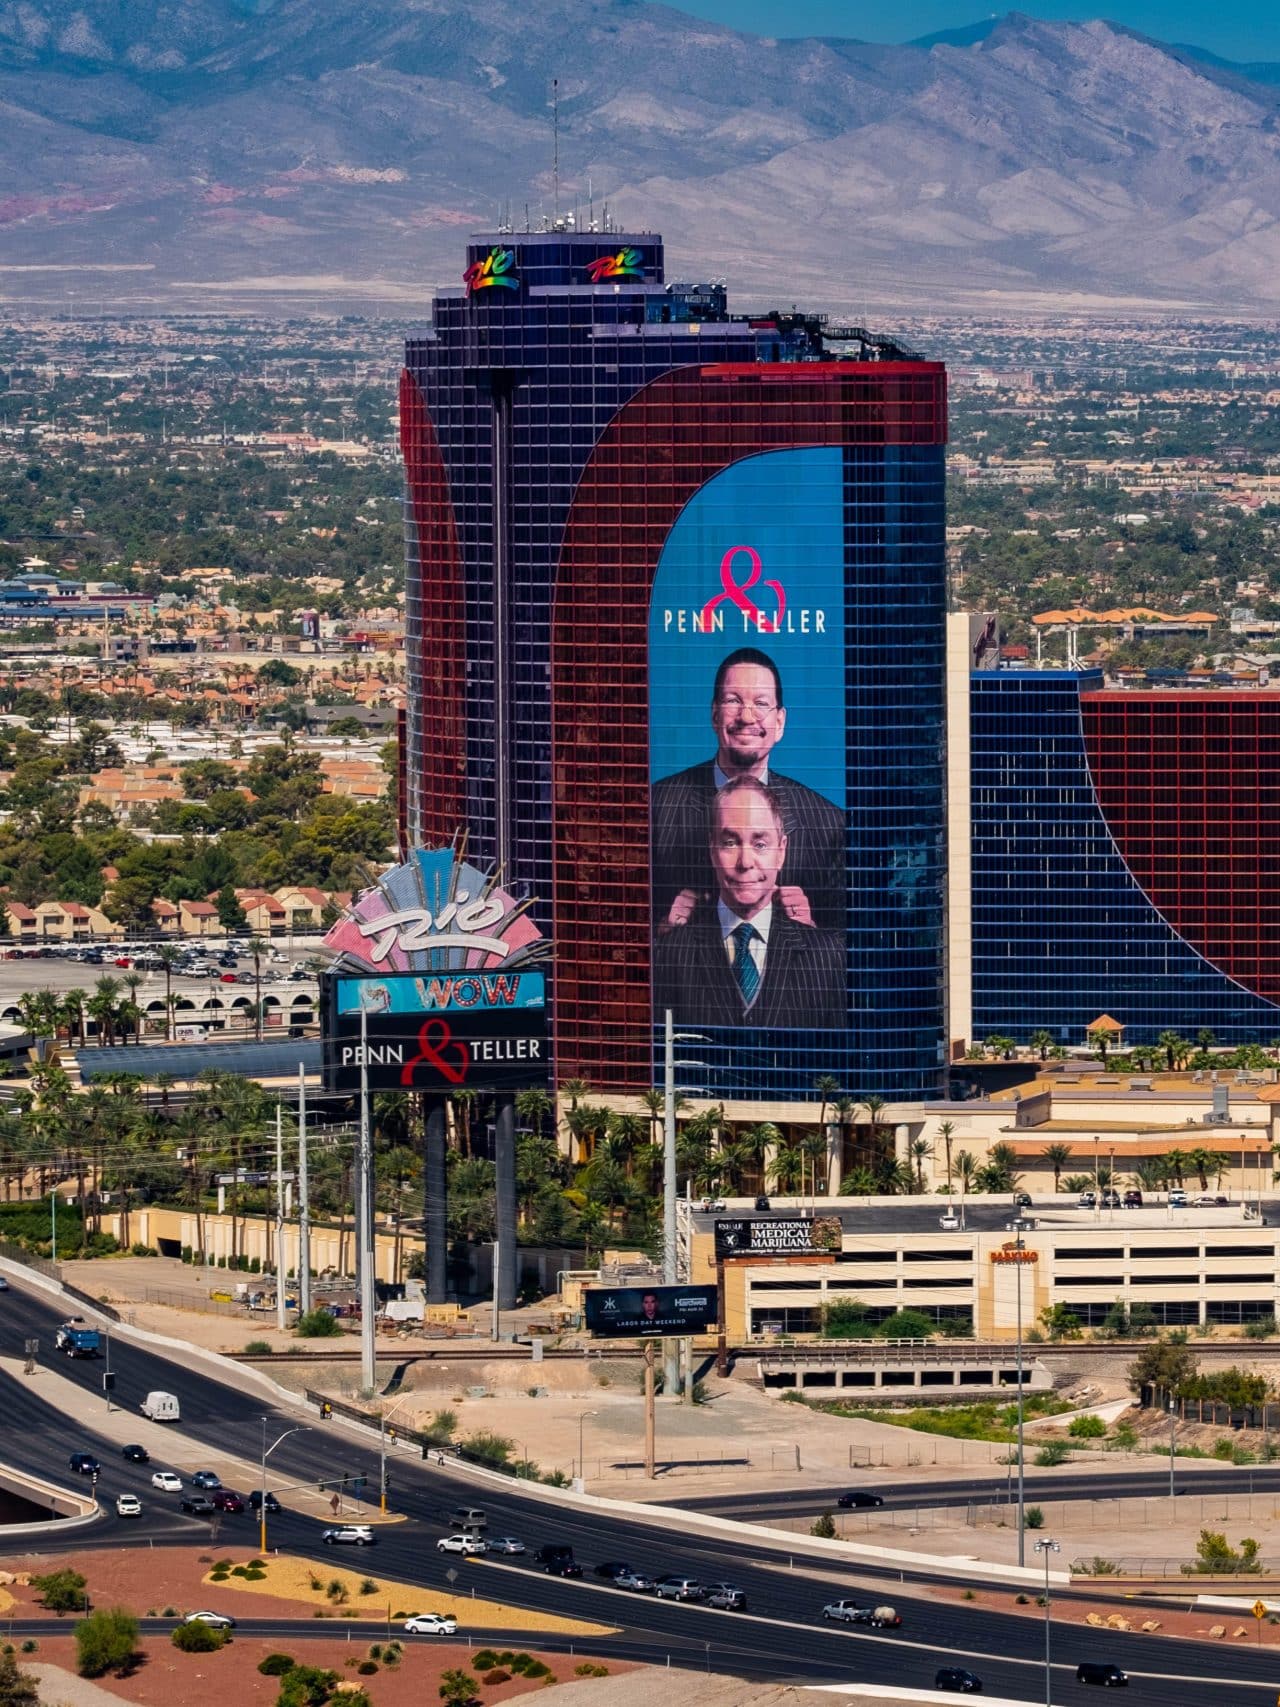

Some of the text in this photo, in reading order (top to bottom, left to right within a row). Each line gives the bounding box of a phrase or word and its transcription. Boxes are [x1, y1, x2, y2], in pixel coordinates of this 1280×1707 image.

[463, 246, 520, 298] Rio
[586, 246, 645, 283] Rio
[664, 610, 724, 633] PENN
[741, 610, 826, 634] TELLER
[358, 888, 509, 962] Rio
[415, 974, 520, 1009] WOW
[342, 1018, 541, 1085] PENN & TELLER
[750, 1222, 812, 1230] RECREATIONAL
[751, 1238, 812, 1248] MARIJUANA
[755, 1229, 812, 1239] MEDICAL
